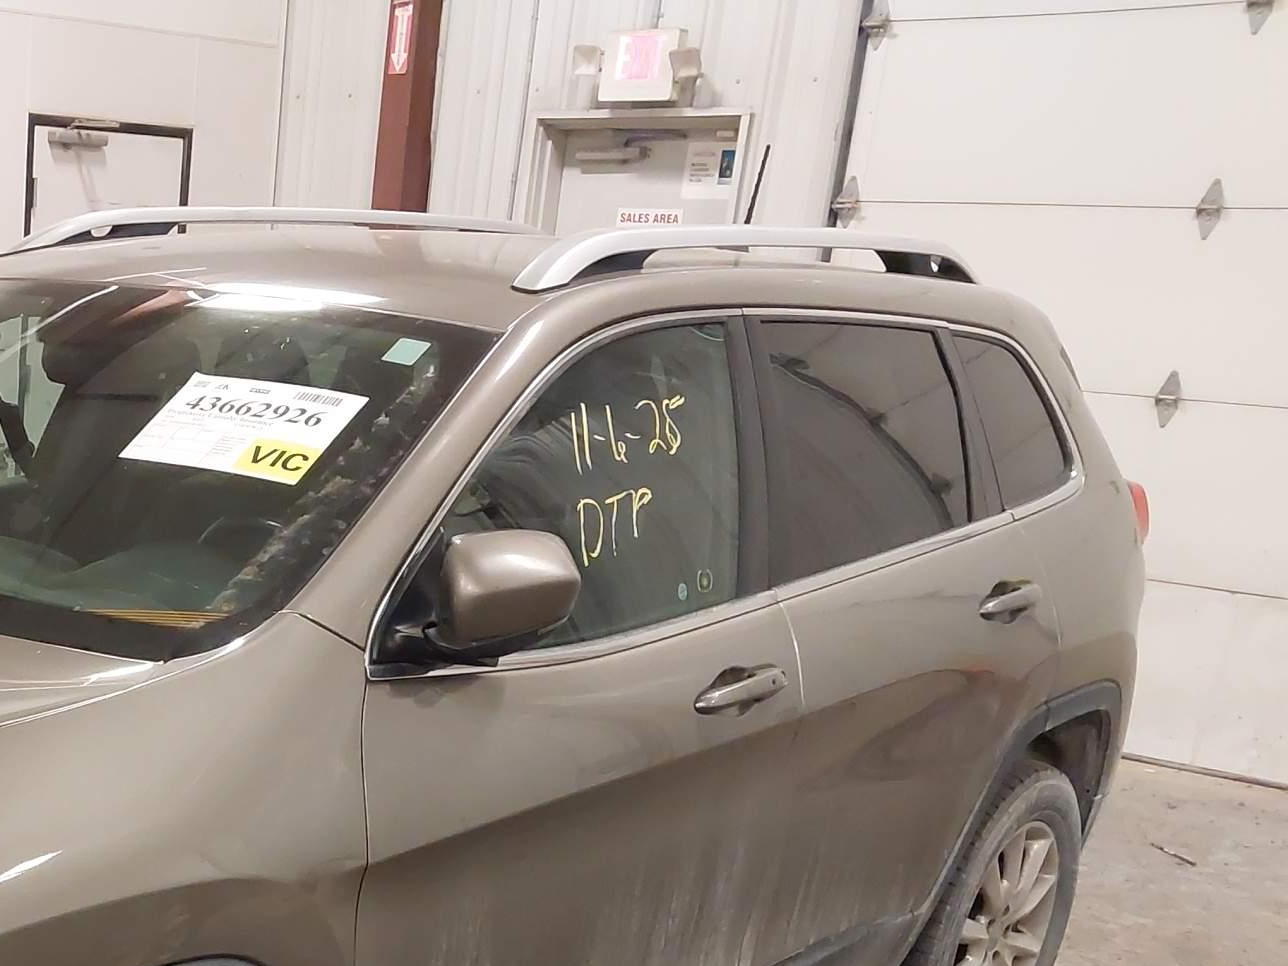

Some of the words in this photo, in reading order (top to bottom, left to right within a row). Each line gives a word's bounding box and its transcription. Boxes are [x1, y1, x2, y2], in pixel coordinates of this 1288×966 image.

[615, 35, 668, 80] EXIT
[620, 212, 650, 224] SALES
[652, 213, 679, 224] AREA
[185, 395, 328, 427] 43662926
[250, 445, 310, 472] VIC
[577, 487, 653, 567] DTP
